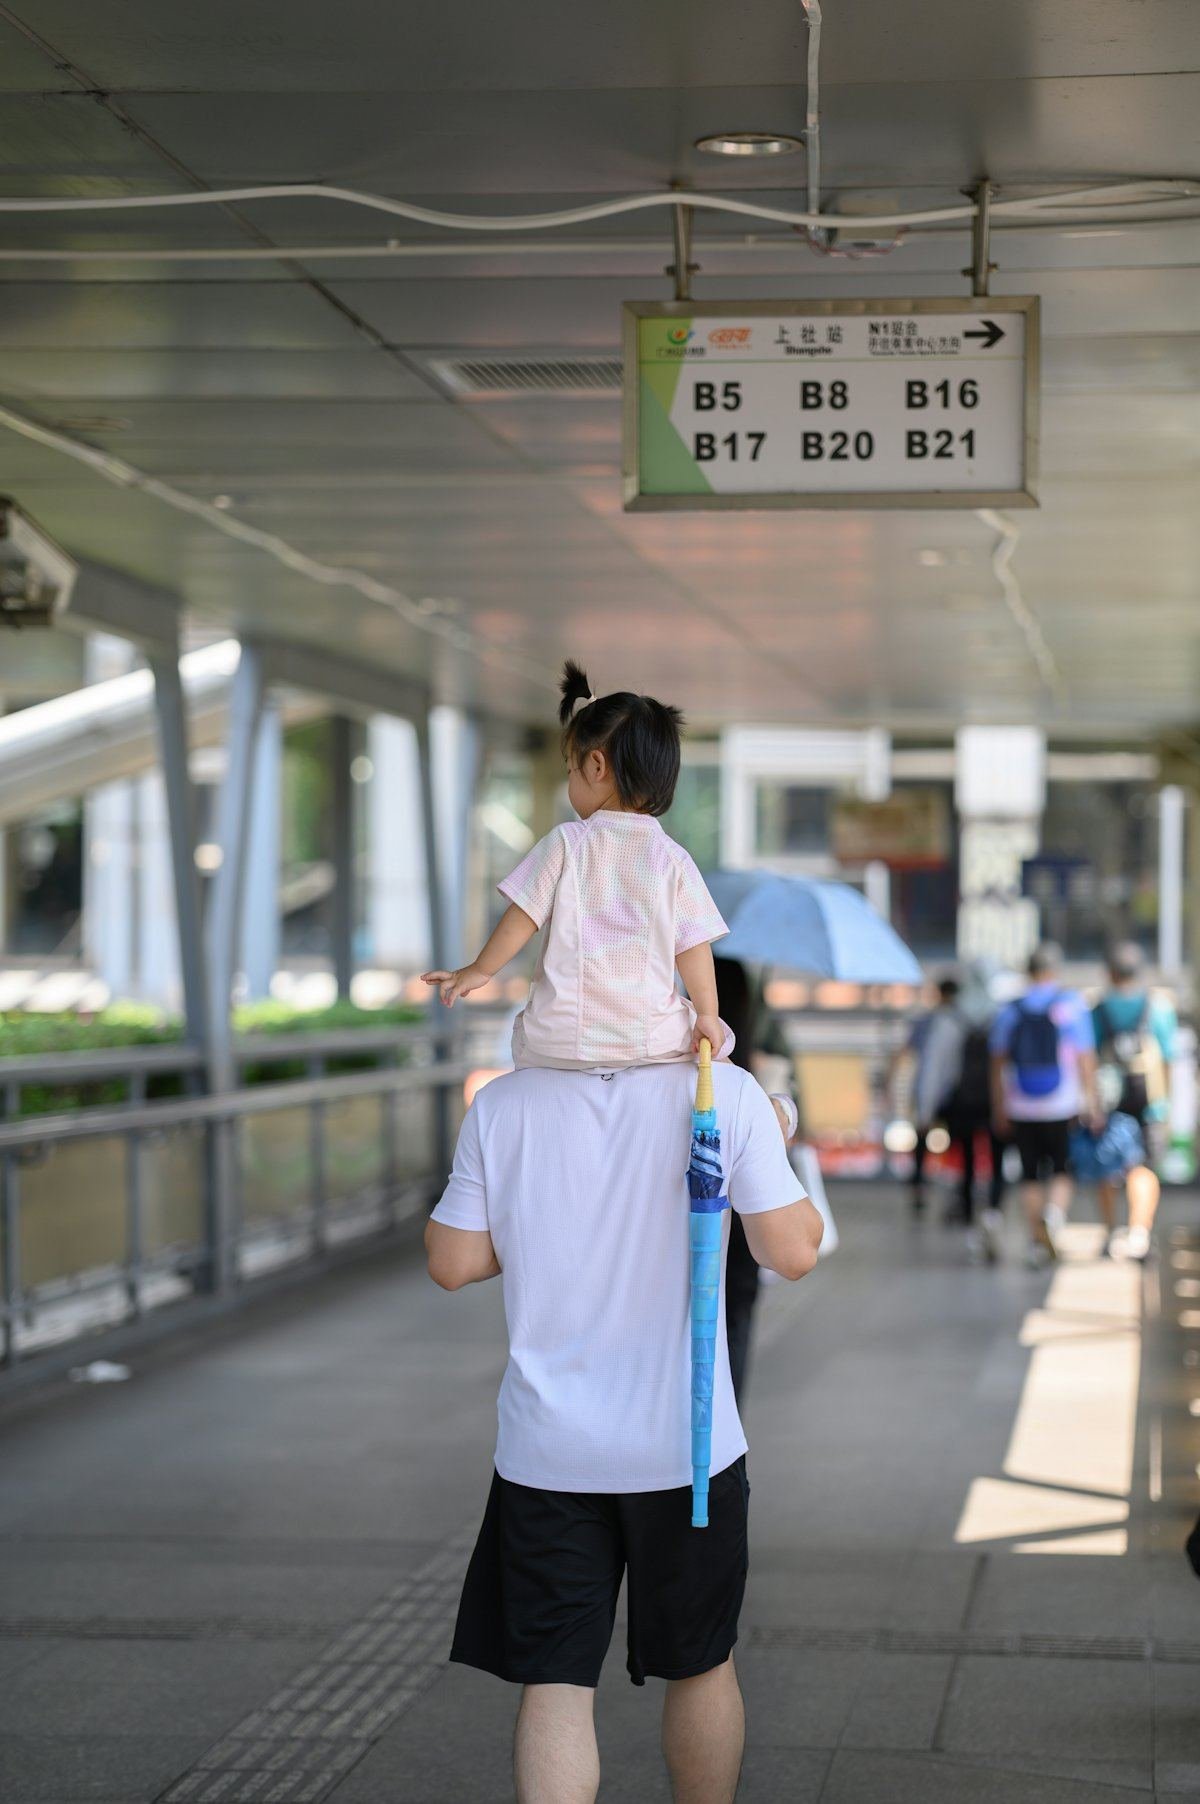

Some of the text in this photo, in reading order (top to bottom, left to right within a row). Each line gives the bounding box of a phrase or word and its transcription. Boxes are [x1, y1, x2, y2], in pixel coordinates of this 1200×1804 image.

[693, 379, 980, 412] B5 B8 B16
[693, 429, 976, 462] B17 B20 B21
